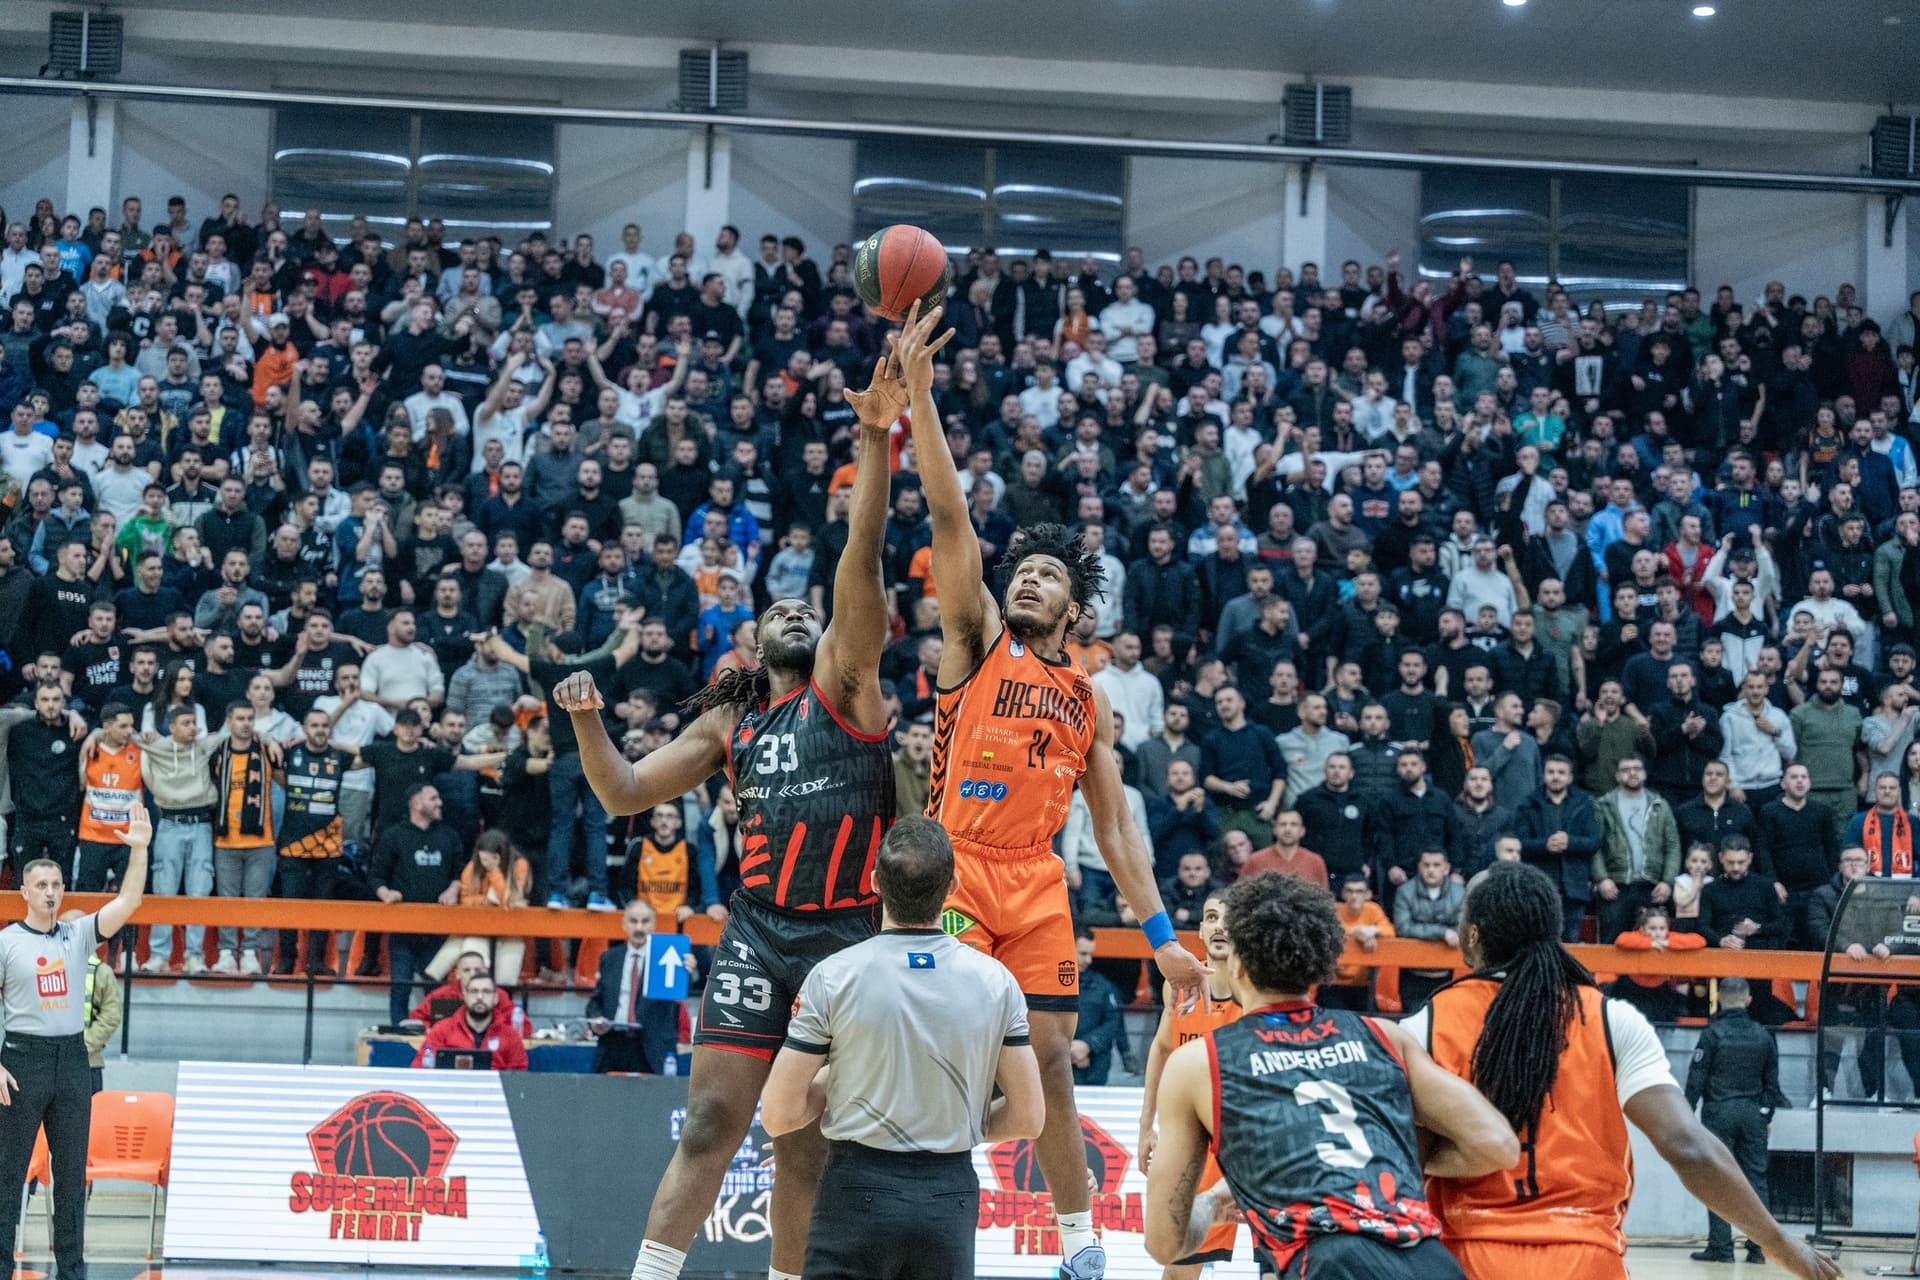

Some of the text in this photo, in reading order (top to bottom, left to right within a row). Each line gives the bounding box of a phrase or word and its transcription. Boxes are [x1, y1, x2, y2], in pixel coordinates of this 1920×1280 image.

[57, 590, 86, 603] BOSS
[86, 661, 120, 677] SINCE
[89, 672, 117, 685] 1945
[296, 669, 334, 680] SINCE
[300, 680, 329, 691] 1945
[755, 733, 799, 775] 33
[1028, 729, 1052, 770] 24
[40, 973, 65, 993] albi
[713, 972, 772, 1012] 33
[1254, 1019, 1340, 1043] VIVAX
[1250, 1040, 1368, 1077] ANDERSON
[1293, 1079, 1374, 1169] 3
[289, 1171, 467, 1218] SUPERLIGA
[977, 1188, 1145, 1233] SUPEIGA
[329, 1213, 422, 1242] FEMRAT
